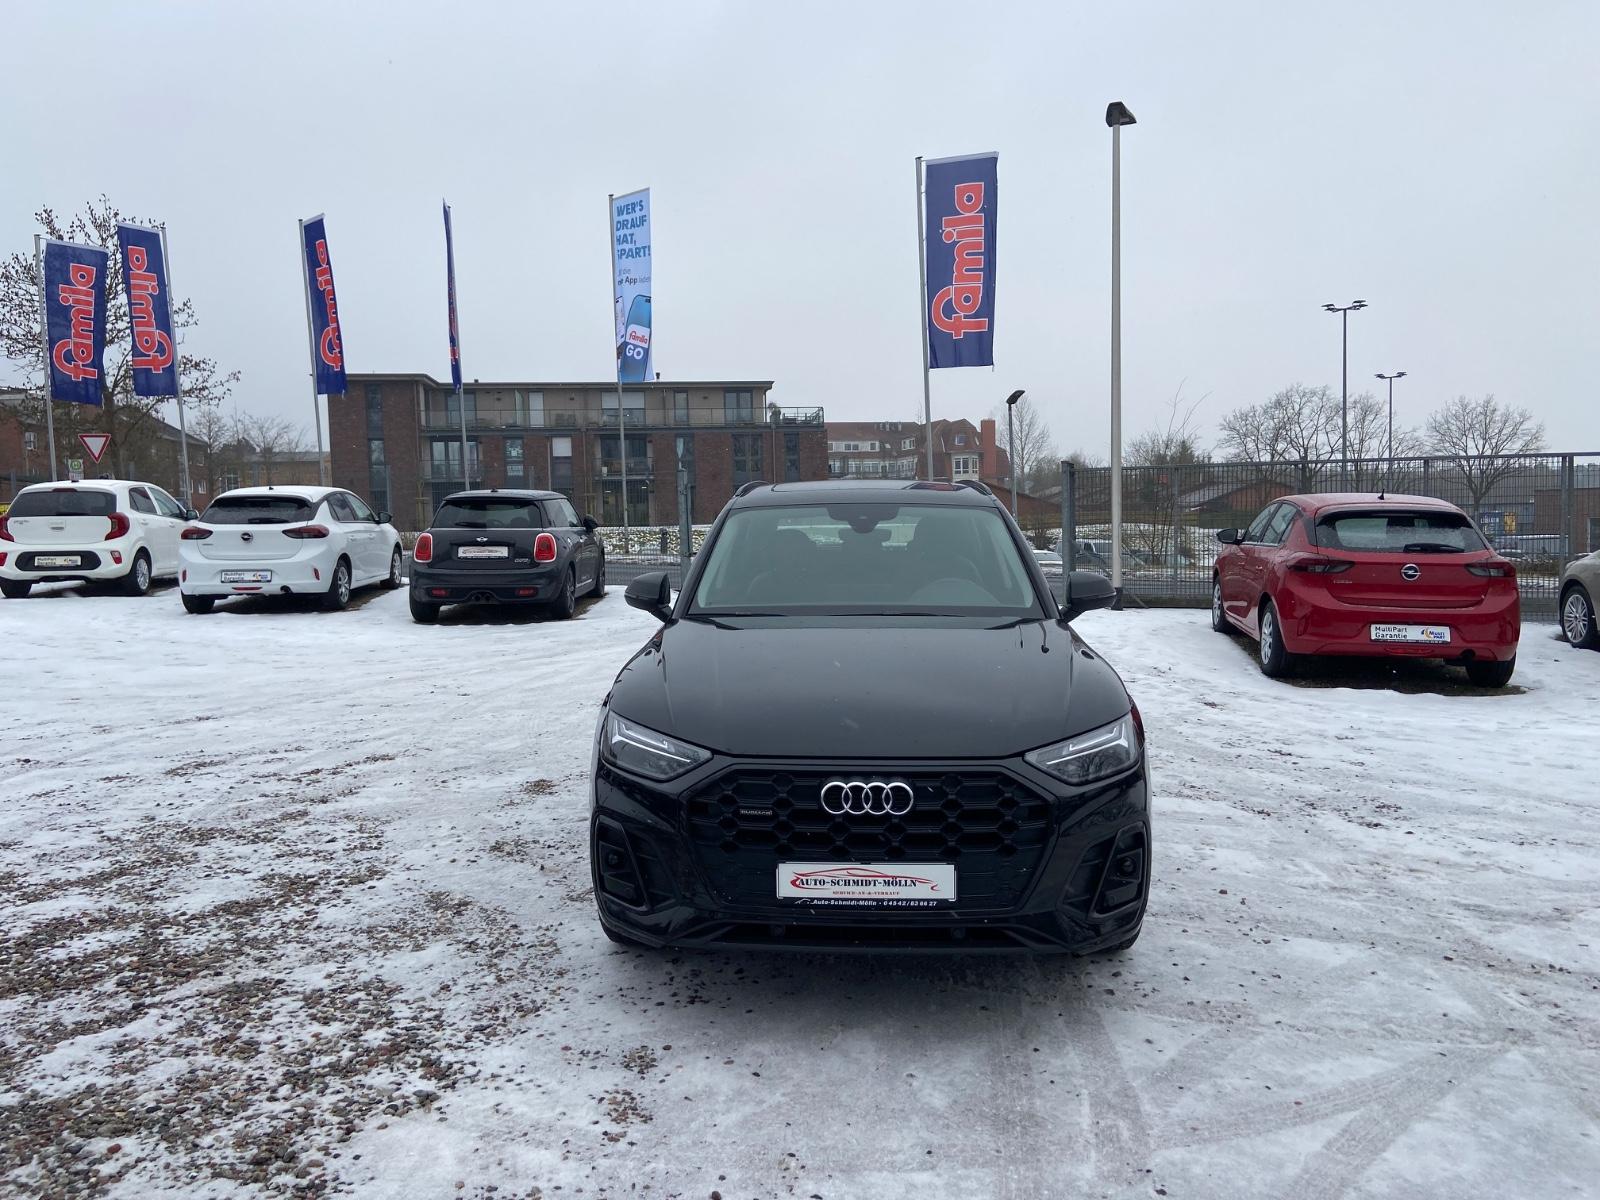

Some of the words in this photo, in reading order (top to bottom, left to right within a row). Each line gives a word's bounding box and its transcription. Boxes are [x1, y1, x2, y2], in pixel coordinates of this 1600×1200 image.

[616, 199, 644, 217] WER'S
[615, 214, 647, 231] DRAUF
[931, 181, 988, 340] famila
[624, 275, 638, 286] App
[315, 239, 342, 371] famila
[53, 262, 98, 381] famila
[629, 330, 648, 344] famila
[626, 344, 644, 360] GO
[798, 877, 918, 888] AUTO-SCHMIDT-MÖLLN
